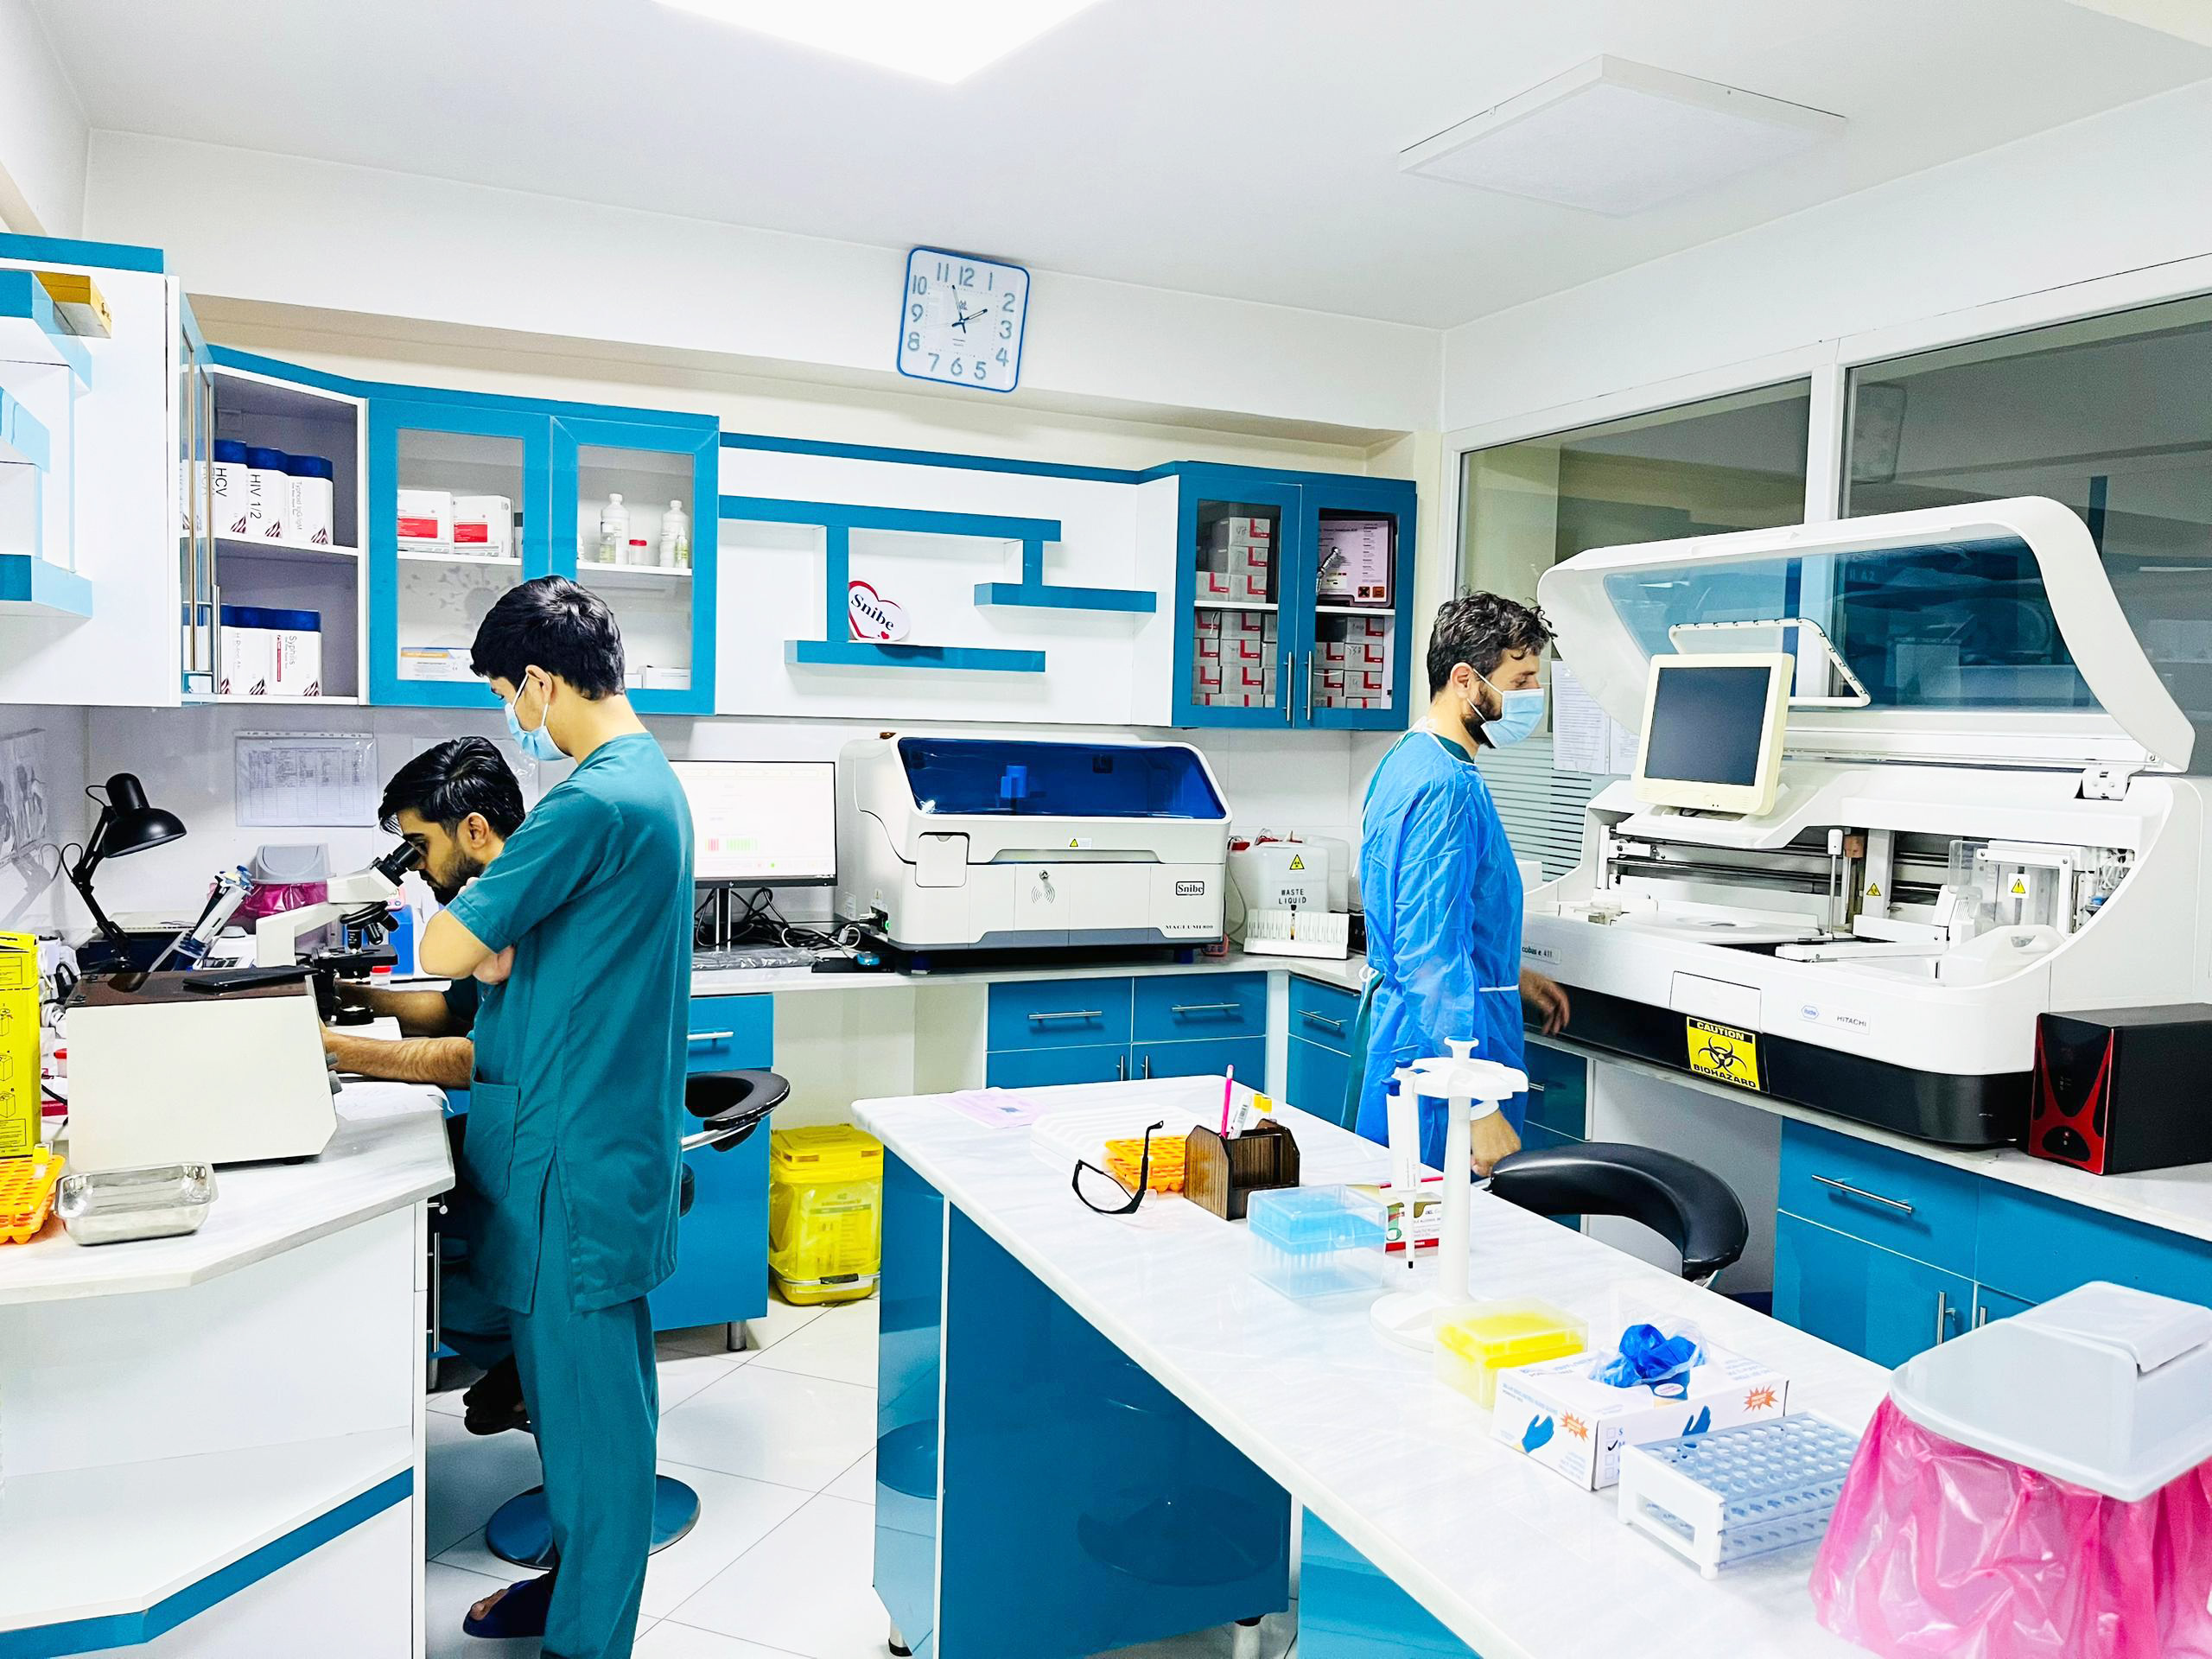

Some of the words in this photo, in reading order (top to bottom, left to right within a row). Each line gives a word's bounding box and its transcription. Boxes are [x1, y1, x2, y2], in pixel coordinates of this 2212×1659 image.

[937, 262, 949, 283] 11
[958, 265, 975, 288] 12
[988, 271, 993, 291] 1
[912, 274, 927, 296] 10
[911, 303, 924, 323] 9
[1001, 292, 1015, 313] 2
[999, 320, 1012, 340] 3
[907, 331, 920, 352] 8
[928, 352, 940, 372] 7
[950, 356, 963, 377] 6
[995, 346, 1009, 367] 4
[974, 360, 987, 380] 5
[215, 467, 227, 498] HCV
[250, 474, 261, 497] HIV
[250, 502, 262, 519] 1/2
[850, 594, 894, 632] Snibe
[287, 635, 297, 665] Syphilis
[1177, 883, 1204, 893] Snibe
[1281, 888, 1305, 897] WASTE
[1278, 896, 1307, 905] LIQUID
[1696, 1021, 1745, 1040] CAUTION
[1836, 1015, 1867, 1027] HITACHI
[1693, 1063, 1757, 1089] BIOHAZARD
